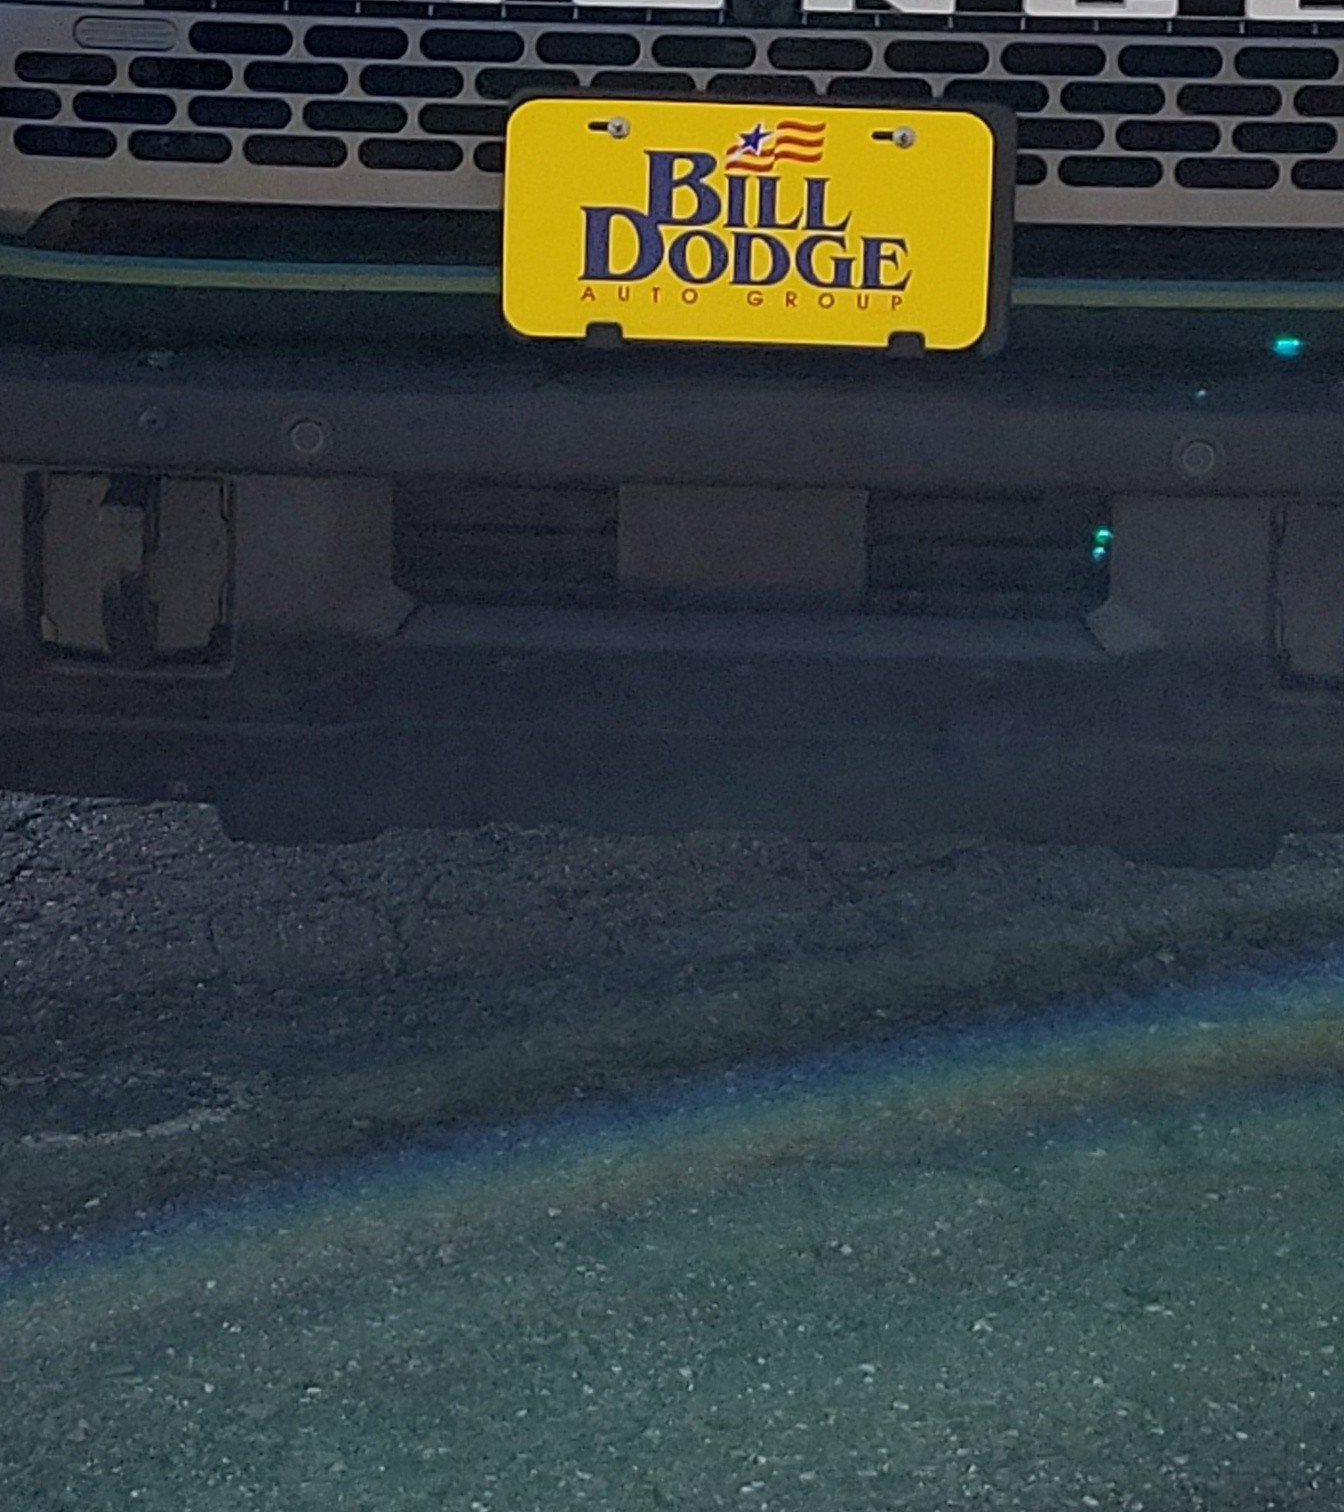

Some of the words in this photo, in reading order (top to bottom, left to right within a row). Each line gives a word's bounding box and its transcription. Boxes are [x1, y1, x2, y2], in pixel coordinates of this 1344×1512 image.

[644, 149, 852, 231] BILL
[578, 206, 912, 291] DODGE
[580, 286, 699, 305] AUTO
[746, 291, 905, 311] GROUP
